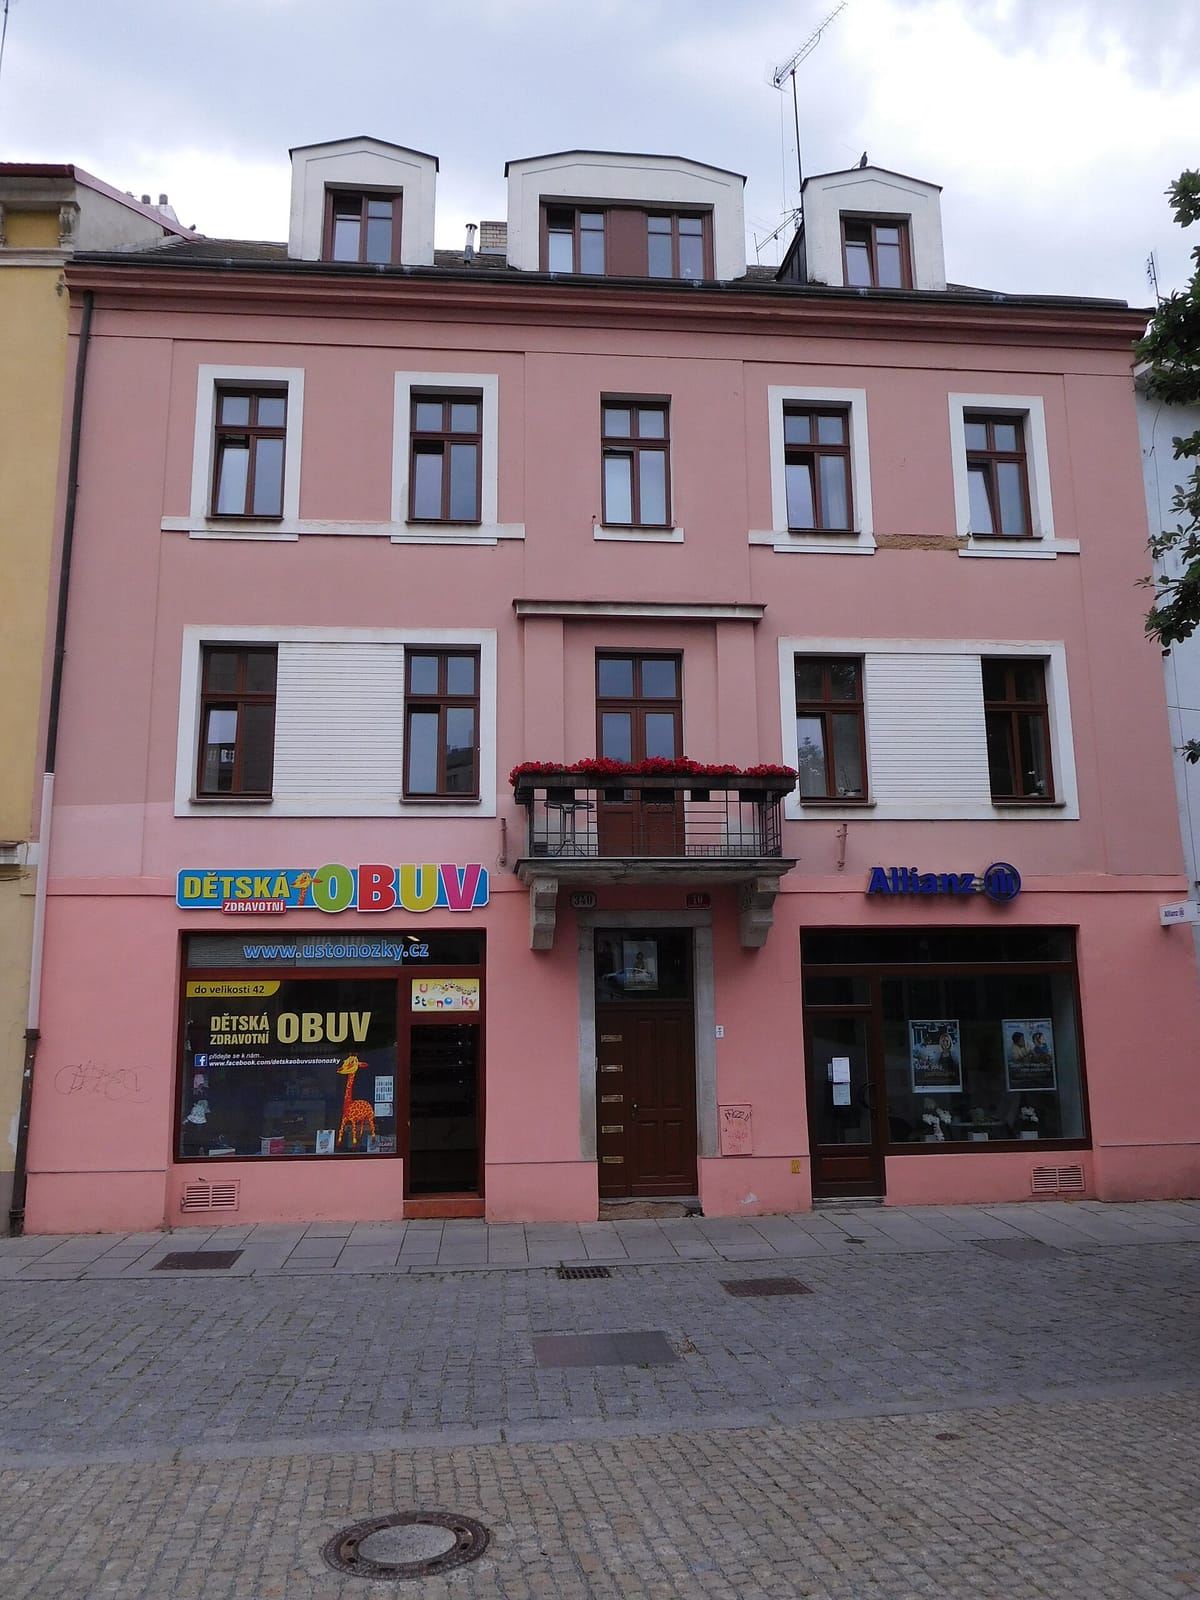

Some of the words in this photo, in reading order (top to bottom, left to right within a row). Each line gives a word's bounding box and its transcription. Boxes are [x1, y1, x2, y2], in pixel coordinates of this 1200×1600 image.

[183, 872, 290, 898] DĚTSKÁ
[312, 863, 482, 912] OBUV
[868, 867, 977, 895] Allianz
[224, 899, 284, 912] ZDRAVOTNÍ
[243, 940, 429, 961] www.ustonozky.cz
[194, 985, 207, 994] do
[209, 984, 251, 994] velikosti
[252, 985, 265, 994] 42
[210, 1012, 270, 1031] DĚTSKÁ
[277, 1011, 372, 1043] OBUV
[209, 1032, 270, 1045] ZDRAVOTNÍ
